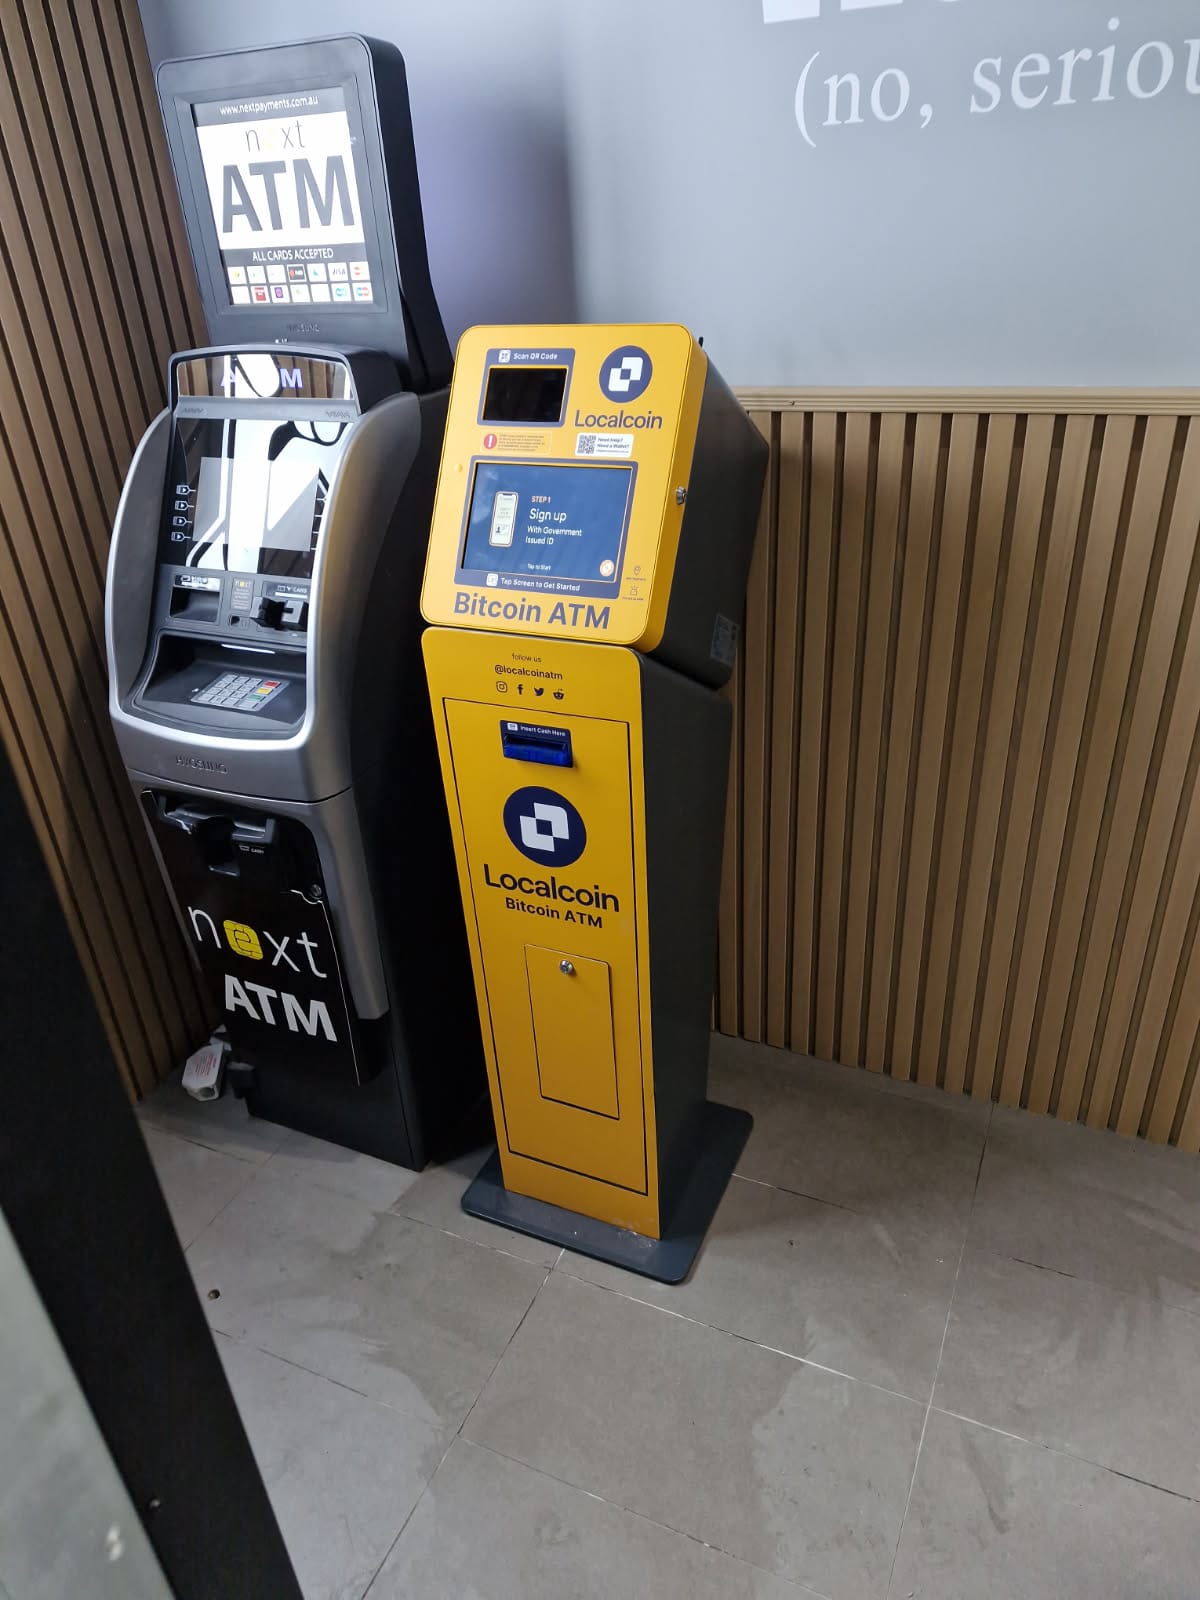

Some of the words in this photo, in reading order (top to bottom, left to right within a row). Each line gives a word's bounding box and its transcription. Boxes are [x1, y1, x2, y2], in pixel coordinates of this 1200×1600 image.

[219, 96, 319, 115] www.nextpayments.com.au
[795, 52, 933, 147] (no,
[245, 120, 305, 152] nxt
[222, 155, 355, 233] ATM
[253, 251, 266, 261] ALL
[267, 250, 293, 261] CARDS
[294, 248, 334, 260] ACCEPTED
[513, 352, 529, 360] Scan
[575, 410, 663, 429] Localcoin
[529, 508, 551, 522] Sign
[553, 512, 567, 523] up
[527, 525, 542, 533] With
[543, 526, 582, 536] Government
[525, 536, 545, 544] Issued
[547, 537, 554, 545] ID
[513, 579, 535, 587] Screen
[556, 583, 580, 591] Started
[453, 591, 541, 622] Bitcoin
[547, 602, 611, 630] ATM
[512, 653, 531, 661] follow
[494, 664, 563, 680] @localcoinatm
[483, 863, 620, 913] Localcoin
[505, 897, 560, 920] Bitcoin
[564, 909, 603, 928] ATM
[225, 974, 338, 1042] ATM
